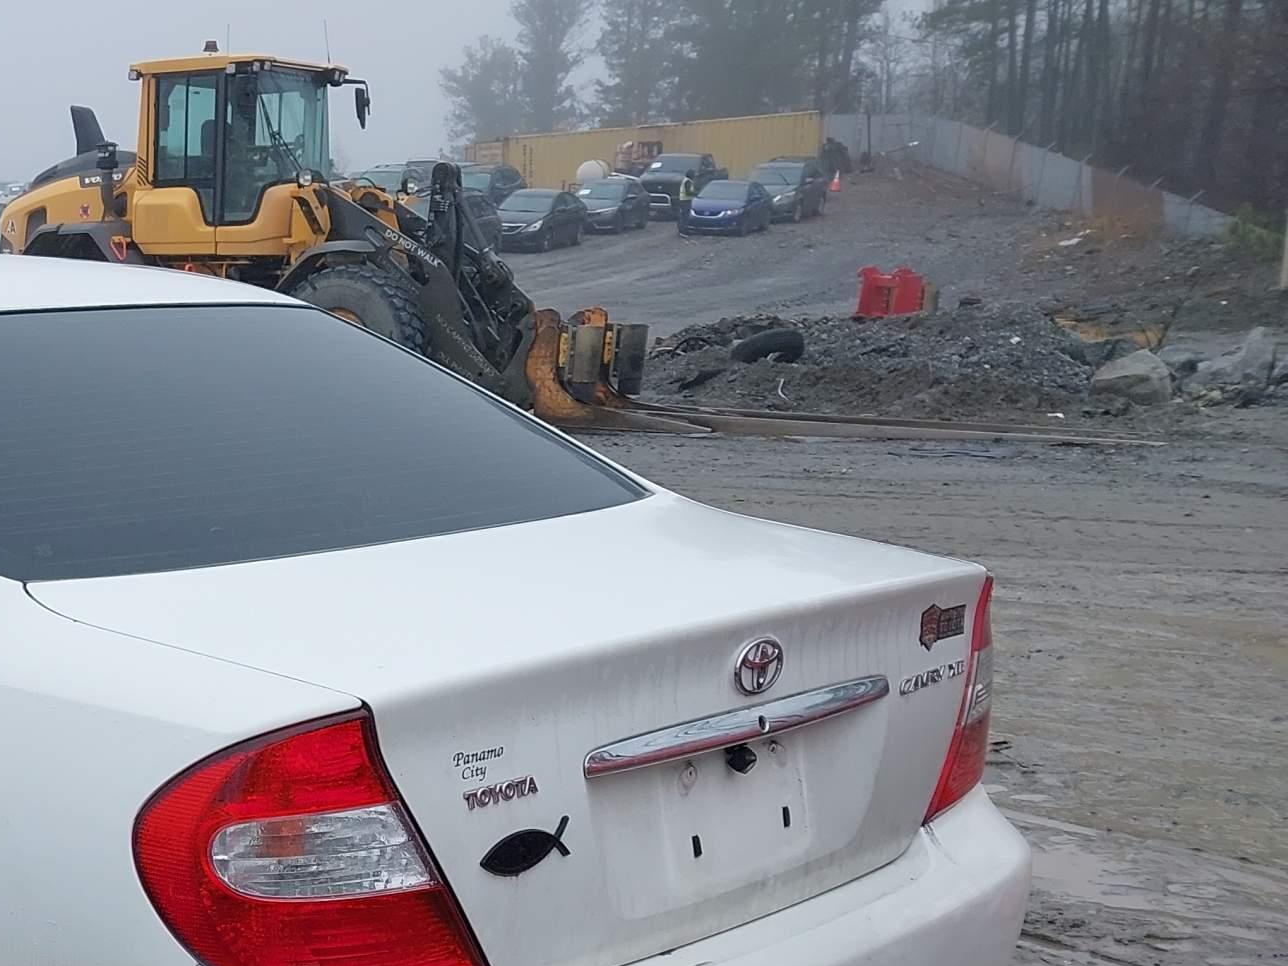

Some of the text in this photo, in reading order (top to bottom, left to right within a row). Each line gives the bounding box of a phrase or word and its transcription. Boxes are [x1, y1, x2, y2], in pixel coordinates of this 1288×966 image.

[385, 229, 441, 268] DO NOT WALK
[461, 765, 487, 781] City
[463, 775, 539, 811] TOYOTA
